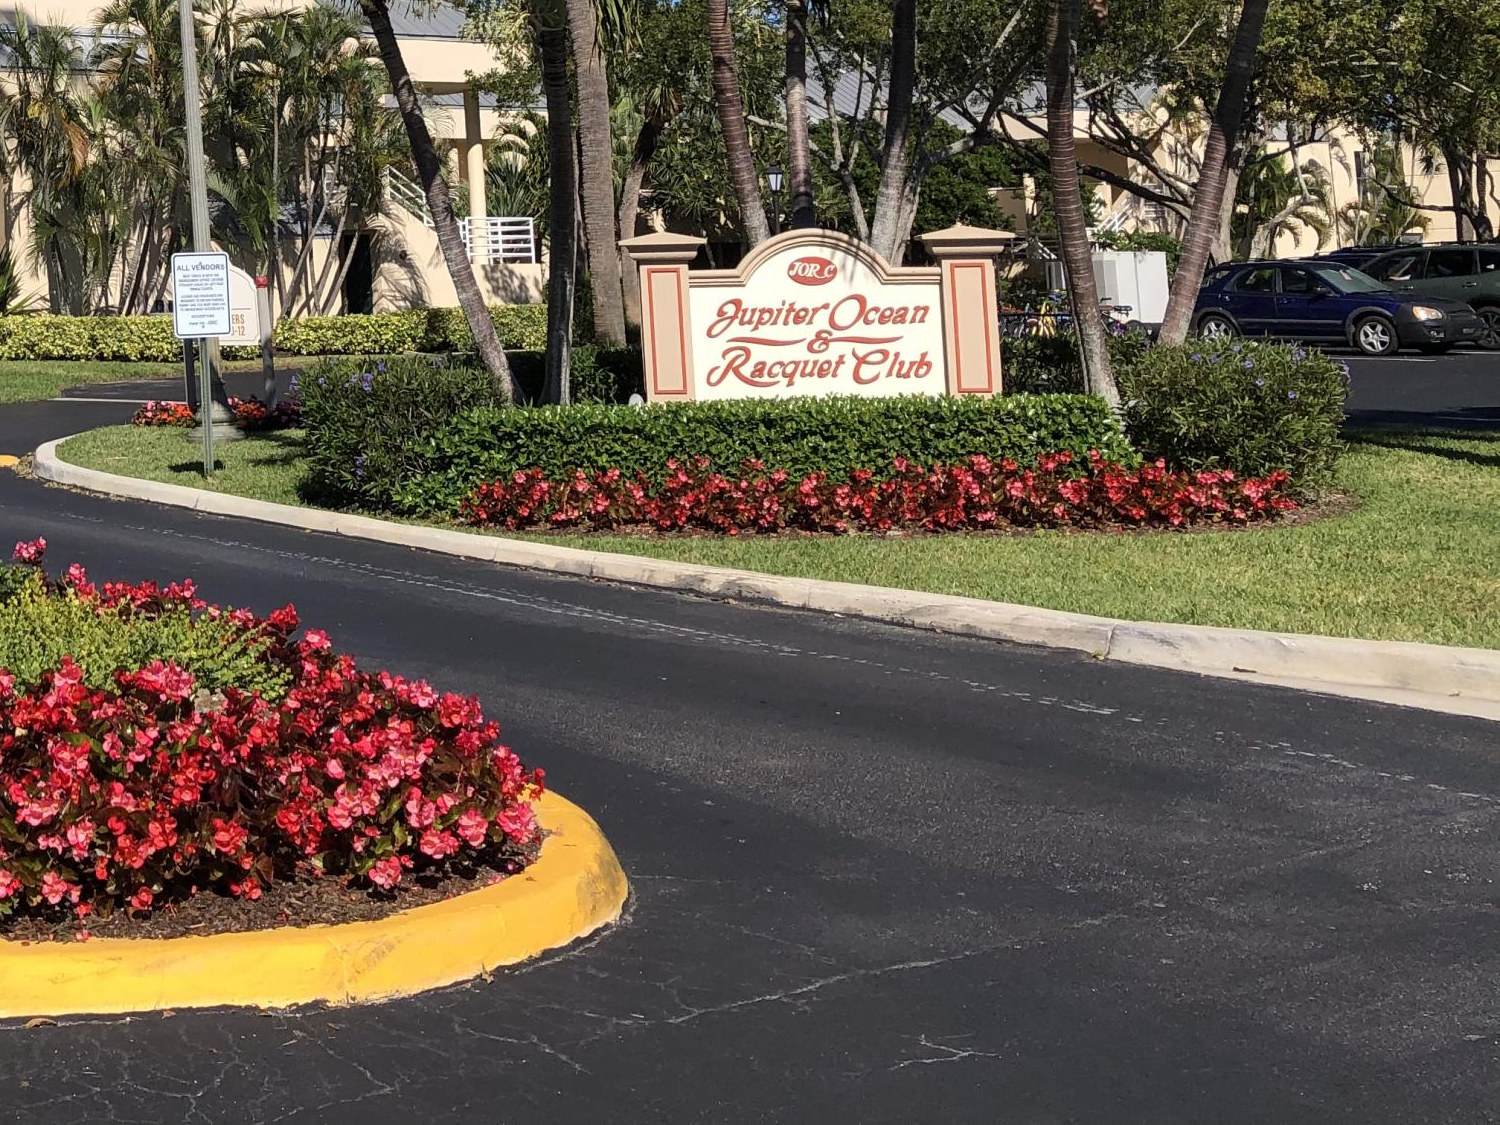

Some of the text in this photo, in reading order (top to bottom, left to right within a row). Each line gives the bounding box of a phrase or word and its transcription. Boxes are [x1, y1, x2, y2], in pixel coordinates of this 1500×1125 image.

[706, 293, 930, 339] Jupiter Ocean
[806, 329, 834, 354] &
[706, 345, 933, 387] Racquet Club
